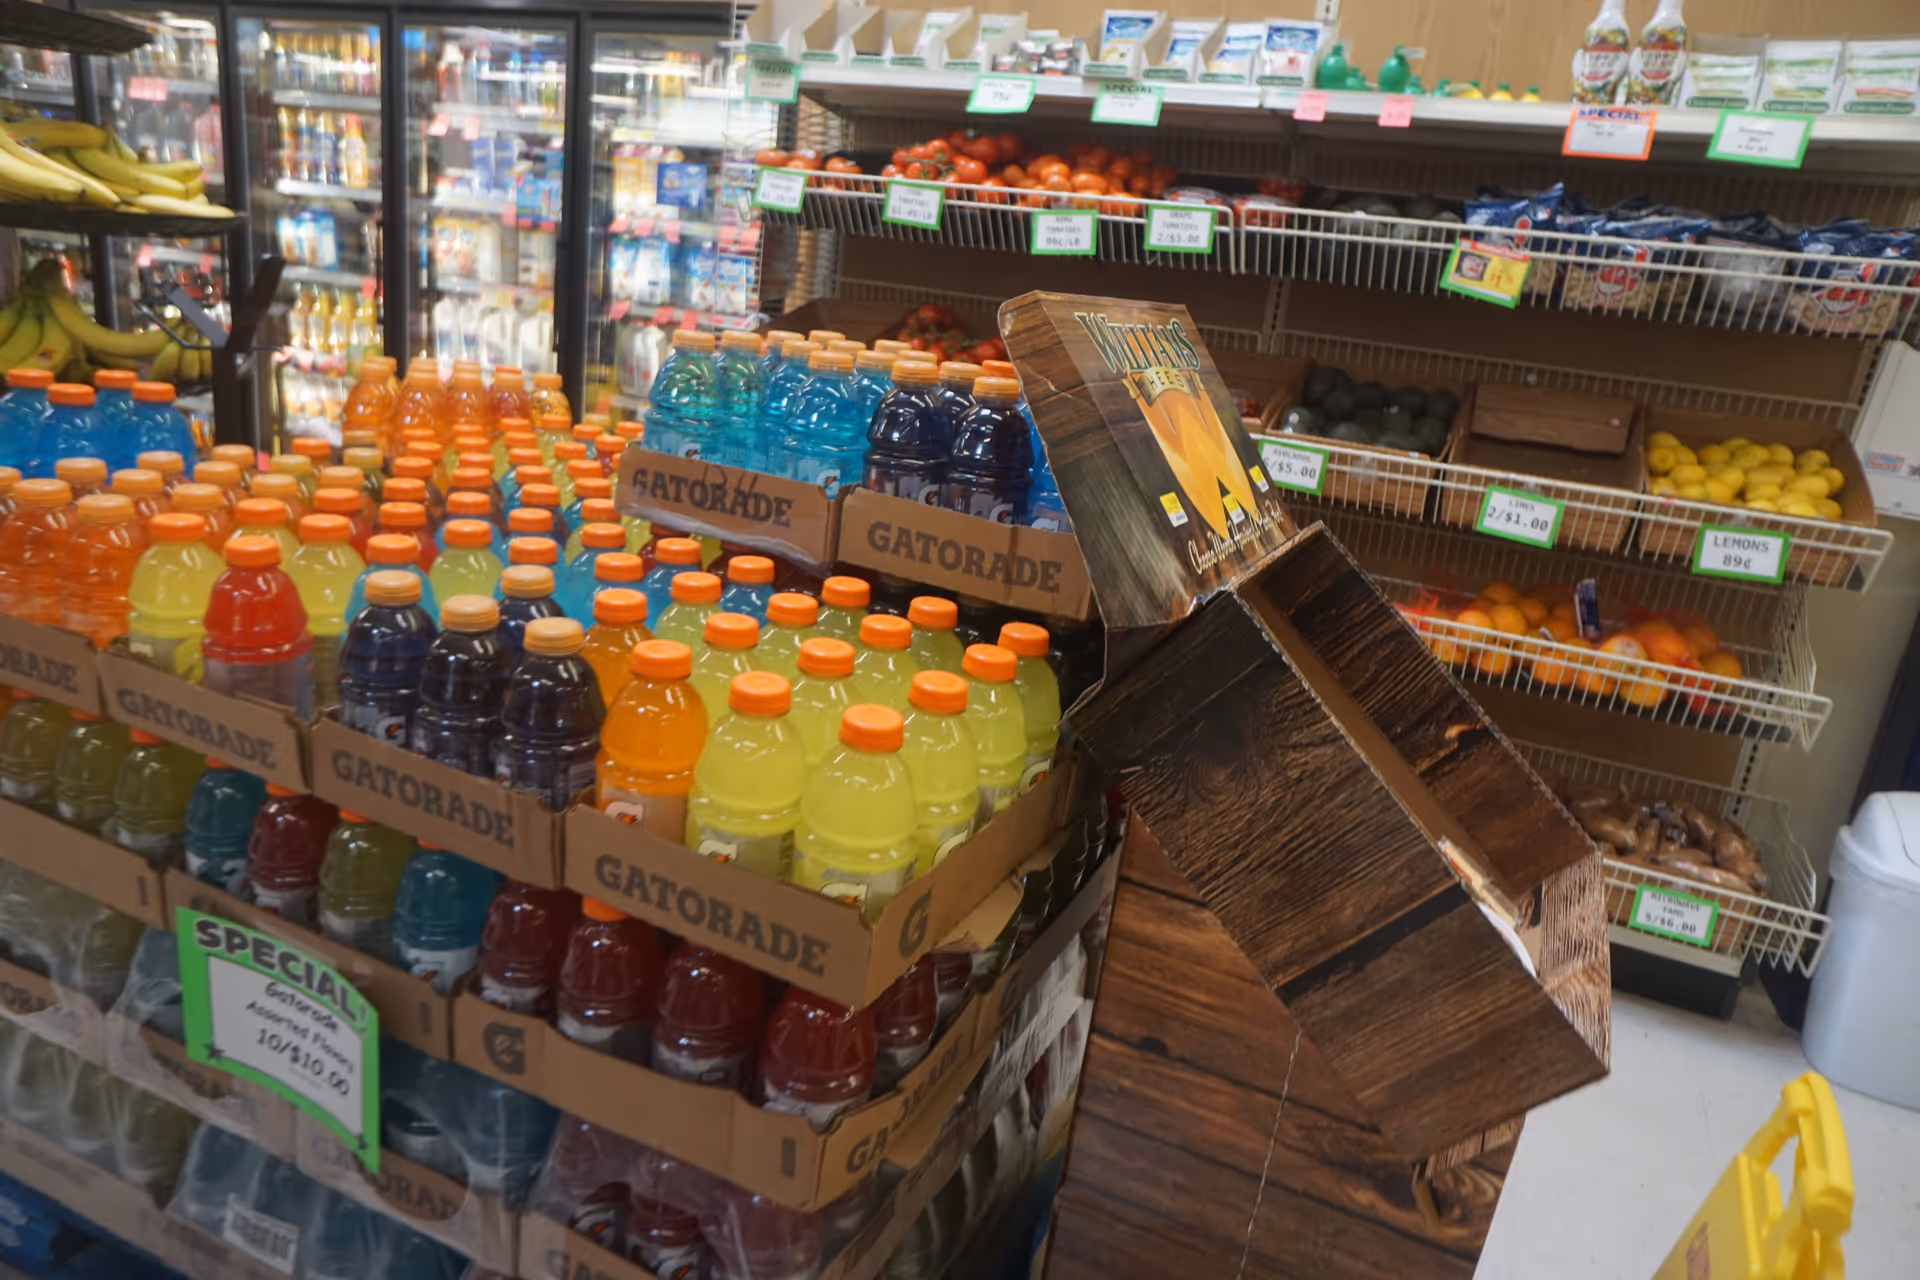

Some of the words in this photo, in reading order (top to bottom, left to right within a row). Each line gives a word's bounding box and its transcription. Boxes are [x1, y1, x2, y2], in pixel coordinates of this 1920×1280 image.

[1074, 311, 1200, 373] WILLIAMS
[632, 468, 793, 529] GATORADE
[1487, 505, 1549, 532] 2/$1.00
[866, 520, 1065, 594] GATORADE
[1712, 535, 1770, 553] LEMONS
[1723, 554, 1753, 570] 89¢
[115, 687, 277, 770] GATORADE
[331, 749, 515, 848] GATORADE
[594, 853, 831, 978] GATORADE
[194, 918, 367, 1035] SPECIAL!
[265, 981, 339, 1034] Gatorade
[245, 1000, 310, 1041] Assorted
[312, 1031, 354, 1074] Flavors
[256, 1027, 350, 1097] 10/$10.00
